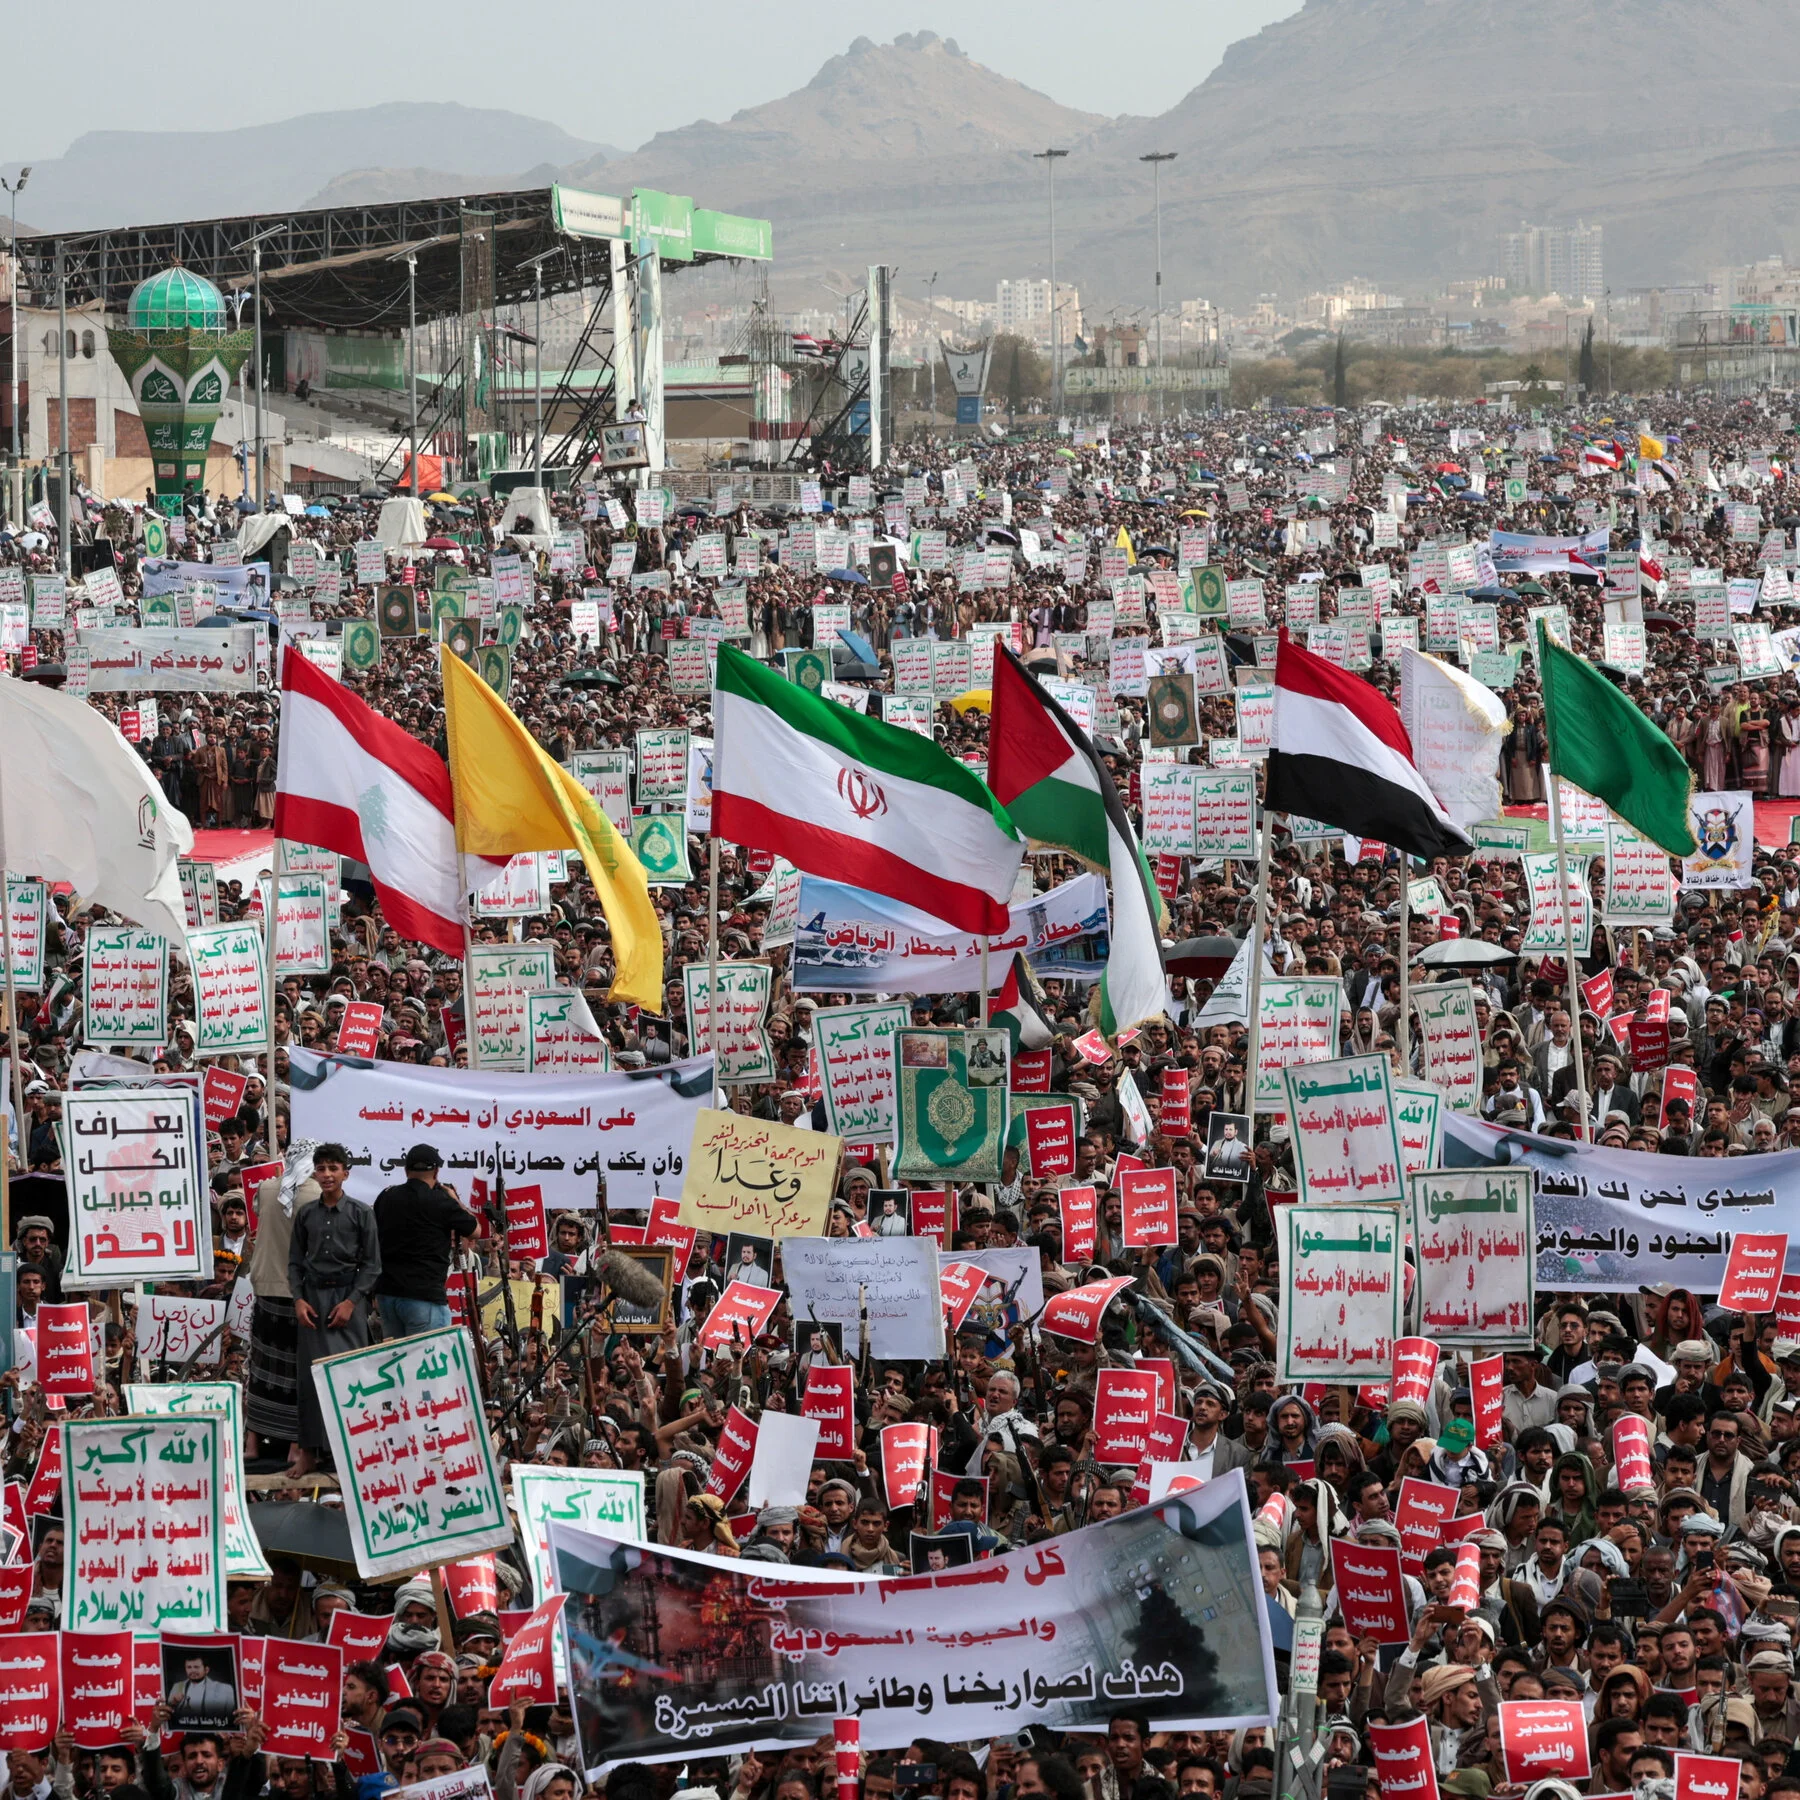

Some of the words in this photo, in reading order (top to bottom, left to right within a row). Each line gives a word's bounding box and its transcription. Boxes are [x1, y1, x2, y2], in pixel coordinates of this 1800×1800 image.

[150, 650, 223, 674] موعدكم
[93, 929, 134, 955] أكبر
[136, 931, 162, 950] الله
[826, 924, 895, 953] الرياض
[901, 935, 957, 962] بمطار
[1036, 921, 1082, 948] مطار
[91, 955, 129, 972] لأمريكا
[131, 957, 161, 972] الموت
[91, 977, 128, 992] لإسرائيل
[131, 978, 160, 991] الموت
[91, 998, 116, 1012] اليهود
[120, 999, 133, 1011] على
[137, 998, 160, 1010] اللعنة
[350, 1008, 377, 1025] جمعة
[91, 1016, 125, 1037] للإسلام
[129, 1014, 159, 1034] النصر
[346, 1025, 375, 1039] التحذير
[1292, 1065, 1383, 1104] قاطعوا
[358, 1100, 404, 1122] نفسه
[411, 1104, 471, 1128] يحترم
[477, 1099, 499, 1129] أن
[504, 1105, 591, 1136] السعودي
[597, 1106, 636, 1132] على
[1298, 1105, 1345, 1134] الأمريكية
[1347, 1104, 1387, 1133] البضائع
[74, 1112, 184, 1140] يعرف
[79, 1147, 186, 1175] الكل
[652, 1145, 683, 1175] وأن
[770, 1146, 796, 1160] جمعة
[794, 1149, 825, 1167] اليوم
[1343, 1137, 1349, 1157] و
[504, 1150, 566, 1175] حصارنا
[607, 1151, 646, 1178] يكف
[1131, 1181, 1167, 1195] جمعة
[1308, 1163, 1396, 1193] الإسرائيلية
[1534, 1168, 1588, 1198] الفدا
[1598, 1179, 1630, 1202] لك
[82, 1184, 154, 1213] جبريل
[160, 1179, 189, 1208] أبو
[1423, 1178, 1519, 1225] قاطعوا
[1640, 1185, 1687, 1209] نحن
[1696, 1186, 1775, 1218] سيدي
[1131, 1200, 1168, 1216] التحذير
[1133, 1221, 1169, 1236] والنفير
[1536, 1223, 1639, 1259] والجيوش
[1421, 1223, 1473, 1267] الأمريكية
[1478, 1228, 1526, 1263] البضائع
[1648, 1231, 1730, 1260] الجنود
[1740, 1244, 1778, 1261] جمعة
[1466, 1263, 1475, 1291] و
[1733, 1265, 1776, 1281] التحذير
[1730, 1286, 1770, 1302] والنفير
[47, 1319, 83, 1335] جمعة
[1422, 1297, 1528, 1332] الإسرائيلية
[45, 1341, 87, 1360] التحذير
[415, 1344, 462, 1377] الله
[46, 1365, 88, 1384] والنفير
[342, 1352, 408, 1409] أكبر
[416, 1387, 469, 1422] الموت
[1107, 1383, 1148, 1402] جمعة
[346, 1402, 411, 1438] لأمريكا
[1104, 1408, 1149, 1425] التحذير
[74, 1428, 153, 1473] أكبر
[161, 1431, 209, 1464] الله
[424, 1420, 477, 1453] الموت
[1104, 1435, 1146, 1452] والنفير
[355, 1434, 419, 1473] لإسرائيل
[412, 1465, 438, 1496] على
[441, 1454, 485, 1484] اللعنة
[77, 1476, 145, 1504] لأمريكا
[151, 1478, 209, 1503] الموت
[361, 1469, 409, 1503] اليهود
[438, 1484, 491, 1531] النصر
[78, 1514, 146, 1548] لإسرائيل
[151, 1513, 209, 1541] الموت
[368, 1500, 430, 1549] للإسلام
[77, 1554, 126, 1585] اليهود
[131, 1553, 159, 1584] على
[166, 1551, 210, 1578] اللعنة
[1023, 1545, 1066, 1587] كل
[76, 1588, 145, 1635] للإسلام
[150, 1585, 212, 1629] النصر
[771, 1618, 914, 1661] السعودية
[926, 1615, 1057, 1650] والحيوية
[71, 1648, 122, 1673] جمعة
[70, 1677, 124, 1701] التحذير
[944, 1665, 1093, 1711] لصواريخنا
[1105, 1662, 1182, 1695] هدف
[655, 1680, 787, 1737] المسيرة
[798, 1675, 932, 1716] وطائراتنا
[72, 1709, 122, 1731] والنفير
[1515, 1707, 1571, 1719] جمعة
[1515, 1720, 1574, 1738] التحذير
[1519, 1740, 1575, 1768] والنفير
